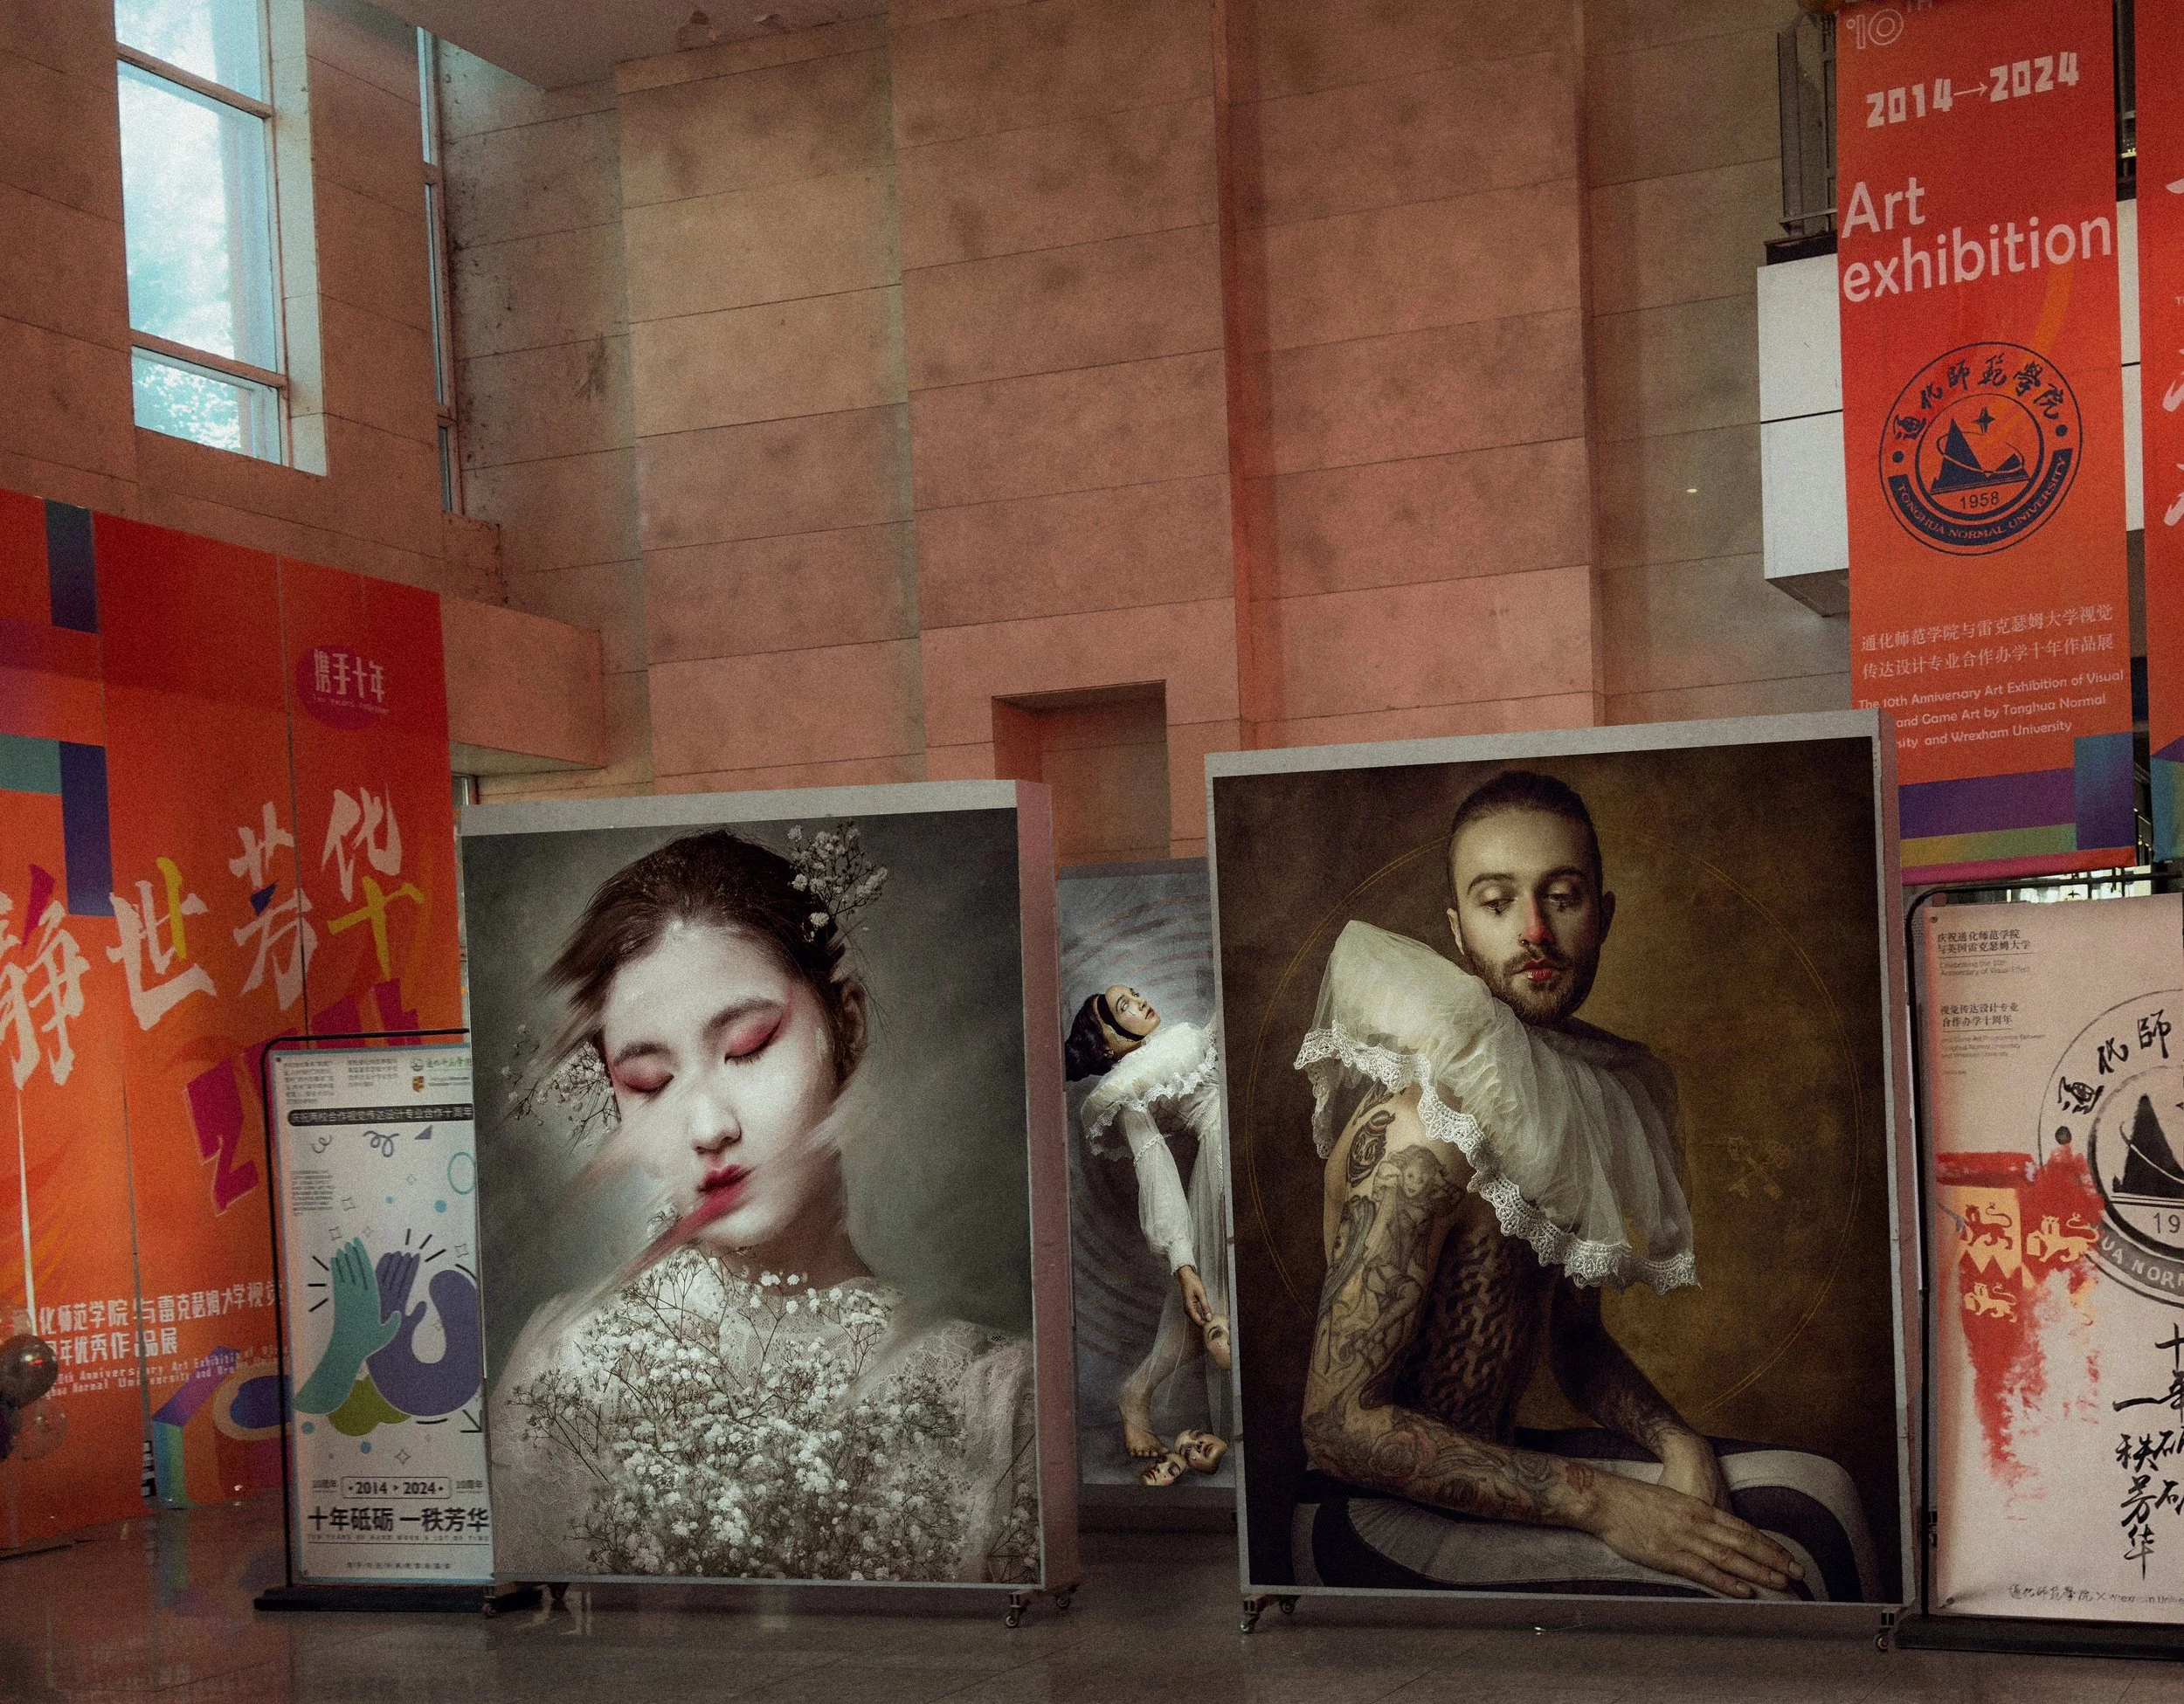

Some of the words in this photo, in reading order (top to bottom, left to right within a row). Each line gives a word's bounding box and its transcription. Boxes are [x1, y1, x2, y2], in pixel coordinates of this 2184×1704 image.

[1866, 79, 1952, 128] 2014
[1989, 52, 2080, 102] 2024
[1842, 176, 1925, 238] Art
[1842, 216, 2111, 302] exhibition
[1949, 527, 2007, 539] NORMAL
[2008, 456, 2066, 528] UNIVERSITY
[1960, 491, 2000, 509] 1958
[1883, 694, 1907, 708] 10th
[1984, 684, 2003, 696] Art
[2008, 678, 2067, 693] Exhibition
[2071, 675, 2084, 686] of
[2086, 670, 2124, 683] Visual
[1896, 716, 1918, 728] and
[1922, 712, 1958, 725] Game
[1961, 709, 1980, 721] Art
[1984, 707, 1999, 719] by
[2002, 700, 2056, 715] Tonghua
[2059, 693, 2107, 708] Normal
[1925, 734, 1947, 746] and
[1951, 728, 2008, 743] Wrexham
[2012, 721, 2072, 736] University
[355, 1481, 387, 1494] 2014
[403, 1481, 436, 1494] 2024
[308, 1506, 393, 1532] 十年砥砺
[399, 1507, 489, 1532] 一秩芳华
